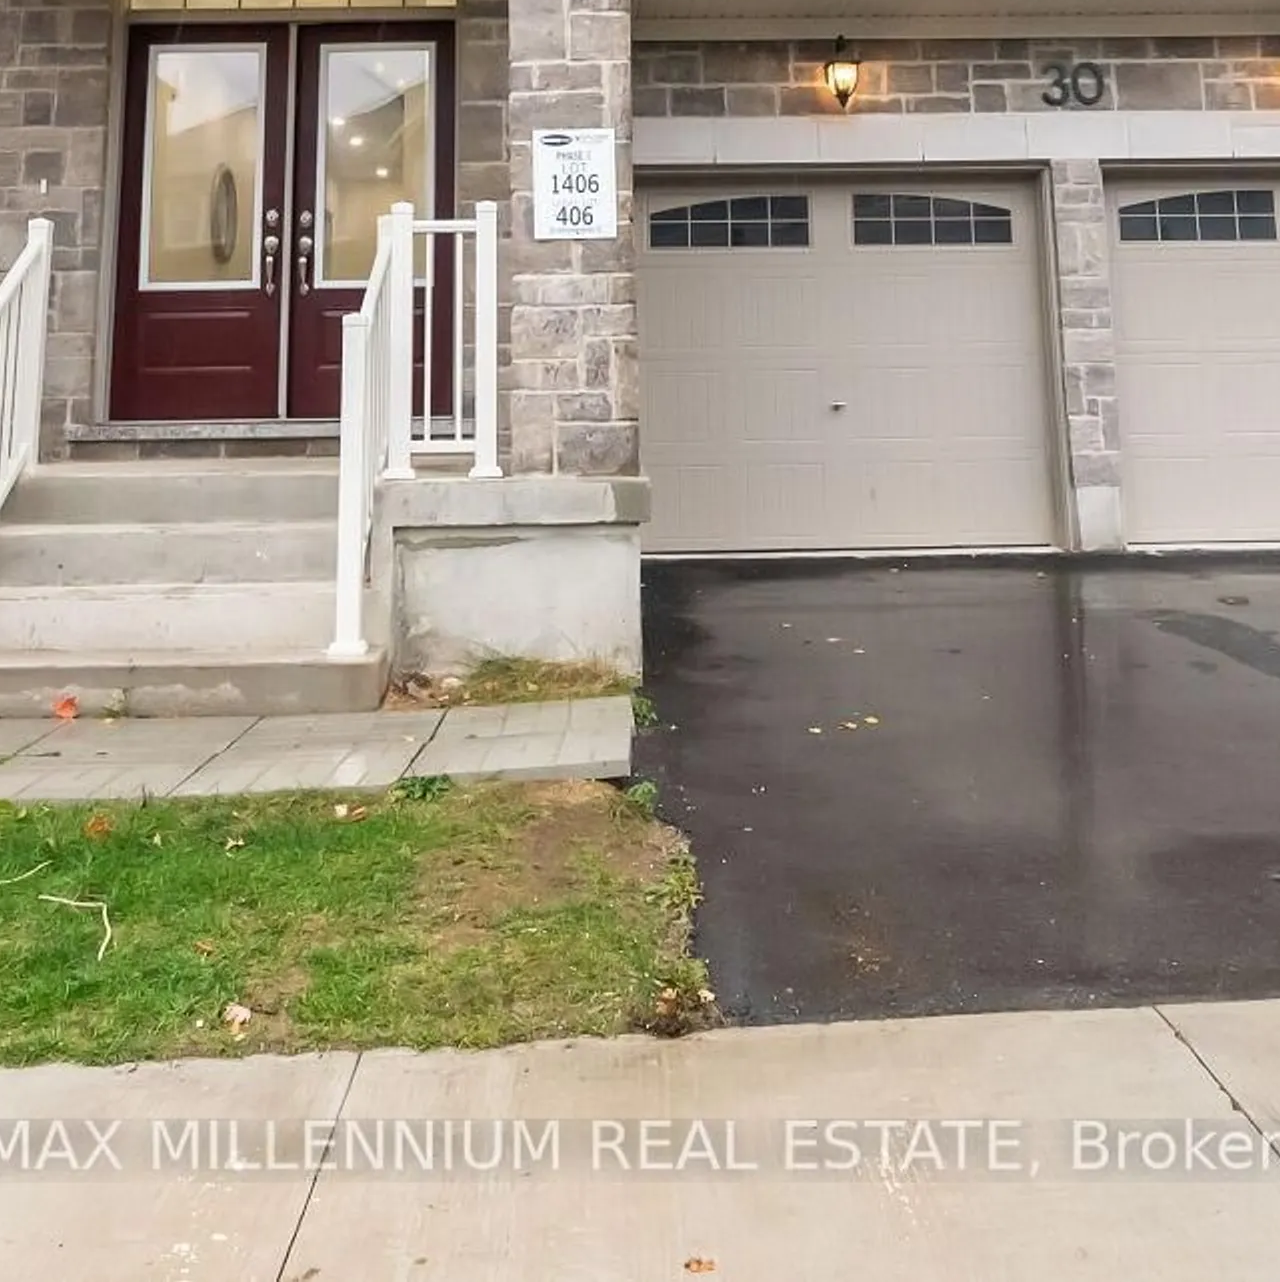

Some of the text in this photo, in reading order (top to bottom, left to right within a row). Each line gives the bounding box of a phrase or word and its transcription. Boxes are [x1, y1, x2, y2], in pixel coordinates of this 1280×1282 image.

[1041, 61, 1104, 107] 30
[552, 174, 600, 194] 1406
[556, 206, 594, 225] 406
